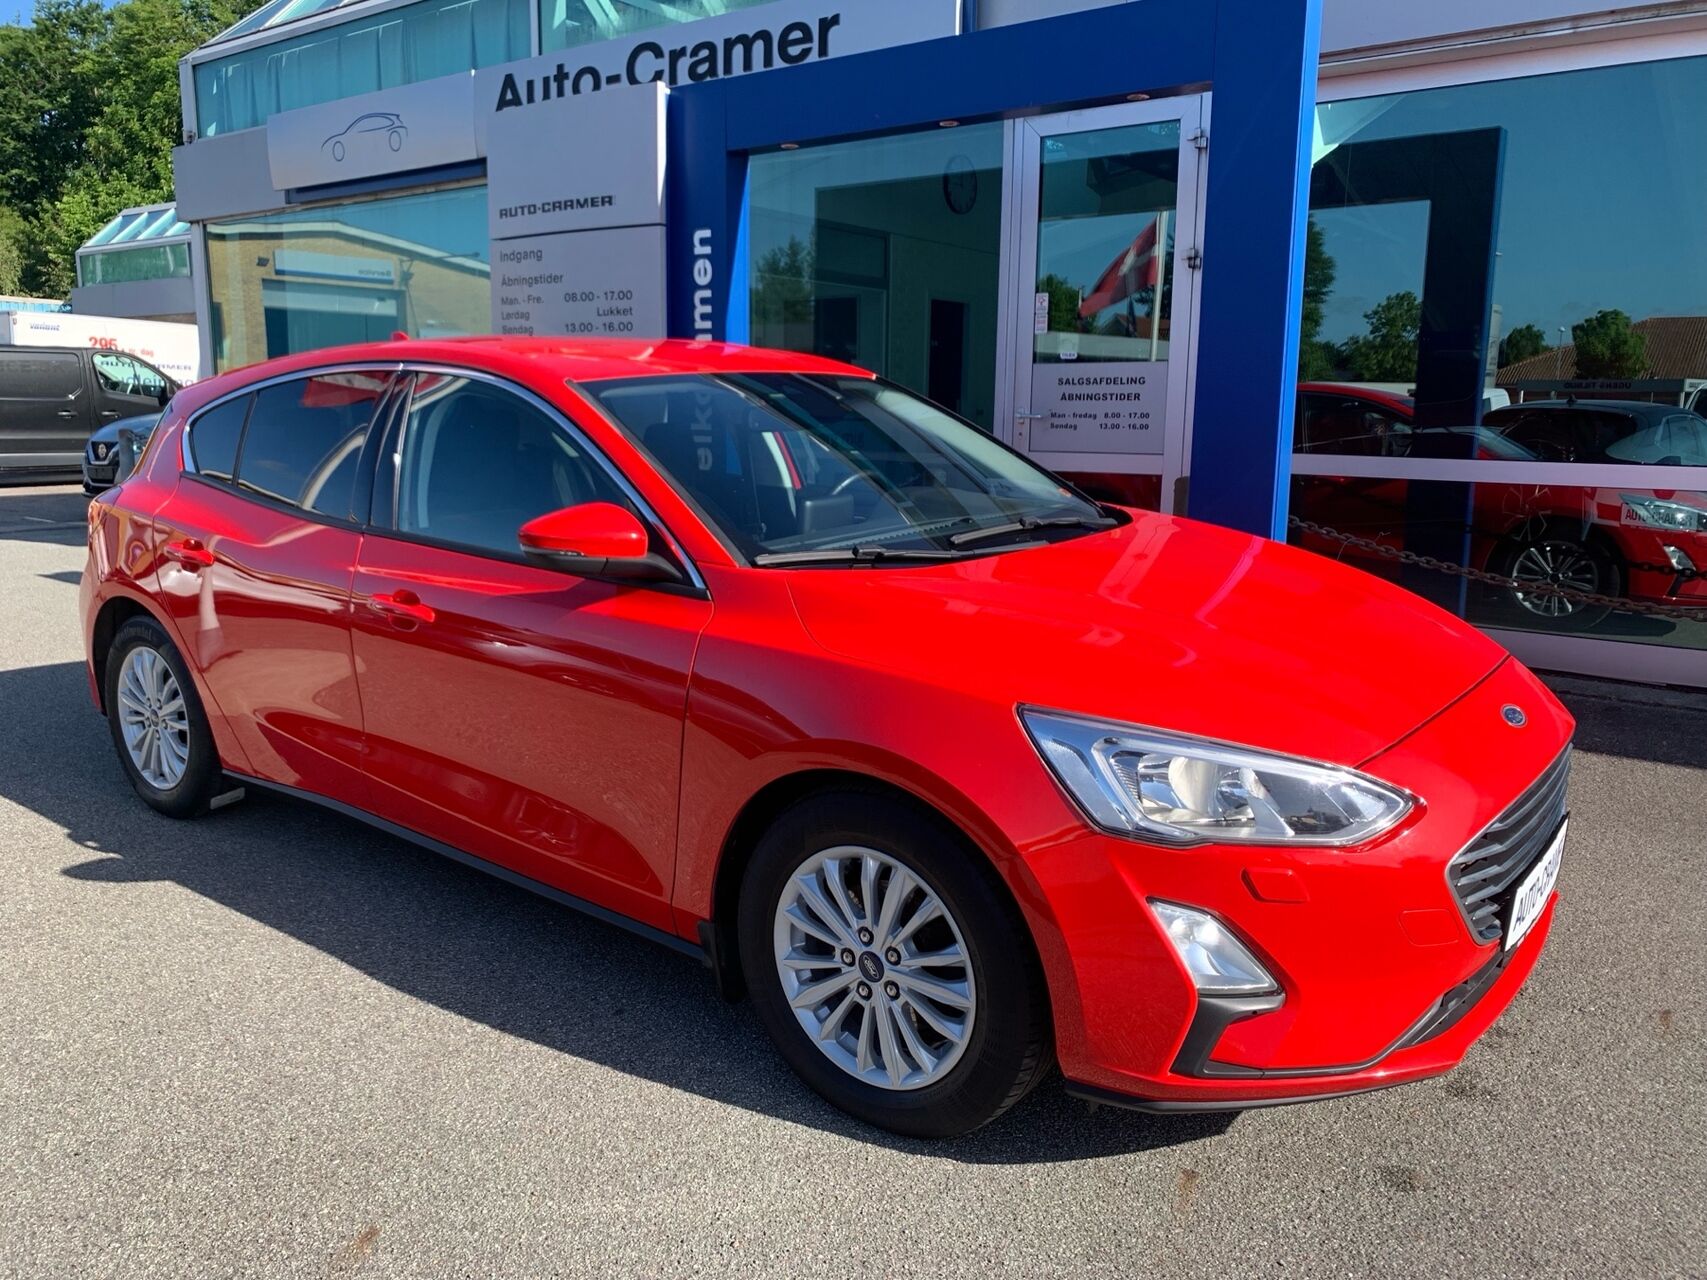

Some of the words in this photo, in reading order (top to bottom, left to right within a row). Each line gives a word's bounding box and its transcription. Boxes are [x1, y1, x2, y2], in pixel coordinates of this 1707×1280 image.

[494, 13, 841, 112] Auto-Cramer
[499, 249, 543, 263] Indgang
[501, 272, 564, 287] Åbningstider
[527, 294, 545, 304] Fre.
[564, 291, 595, 303] 08.00
[603, 289, 633, 301] 17.00
[596, 306, 634, 317] Lukket
[564, 322, 594, 333] 13.00
[602, 321, 634, 332] 16.00
[1057, 376, 1147, 387] SALGSAFDELING
[1060, 391, 1142, 401] ÅBNINGSTIDER
